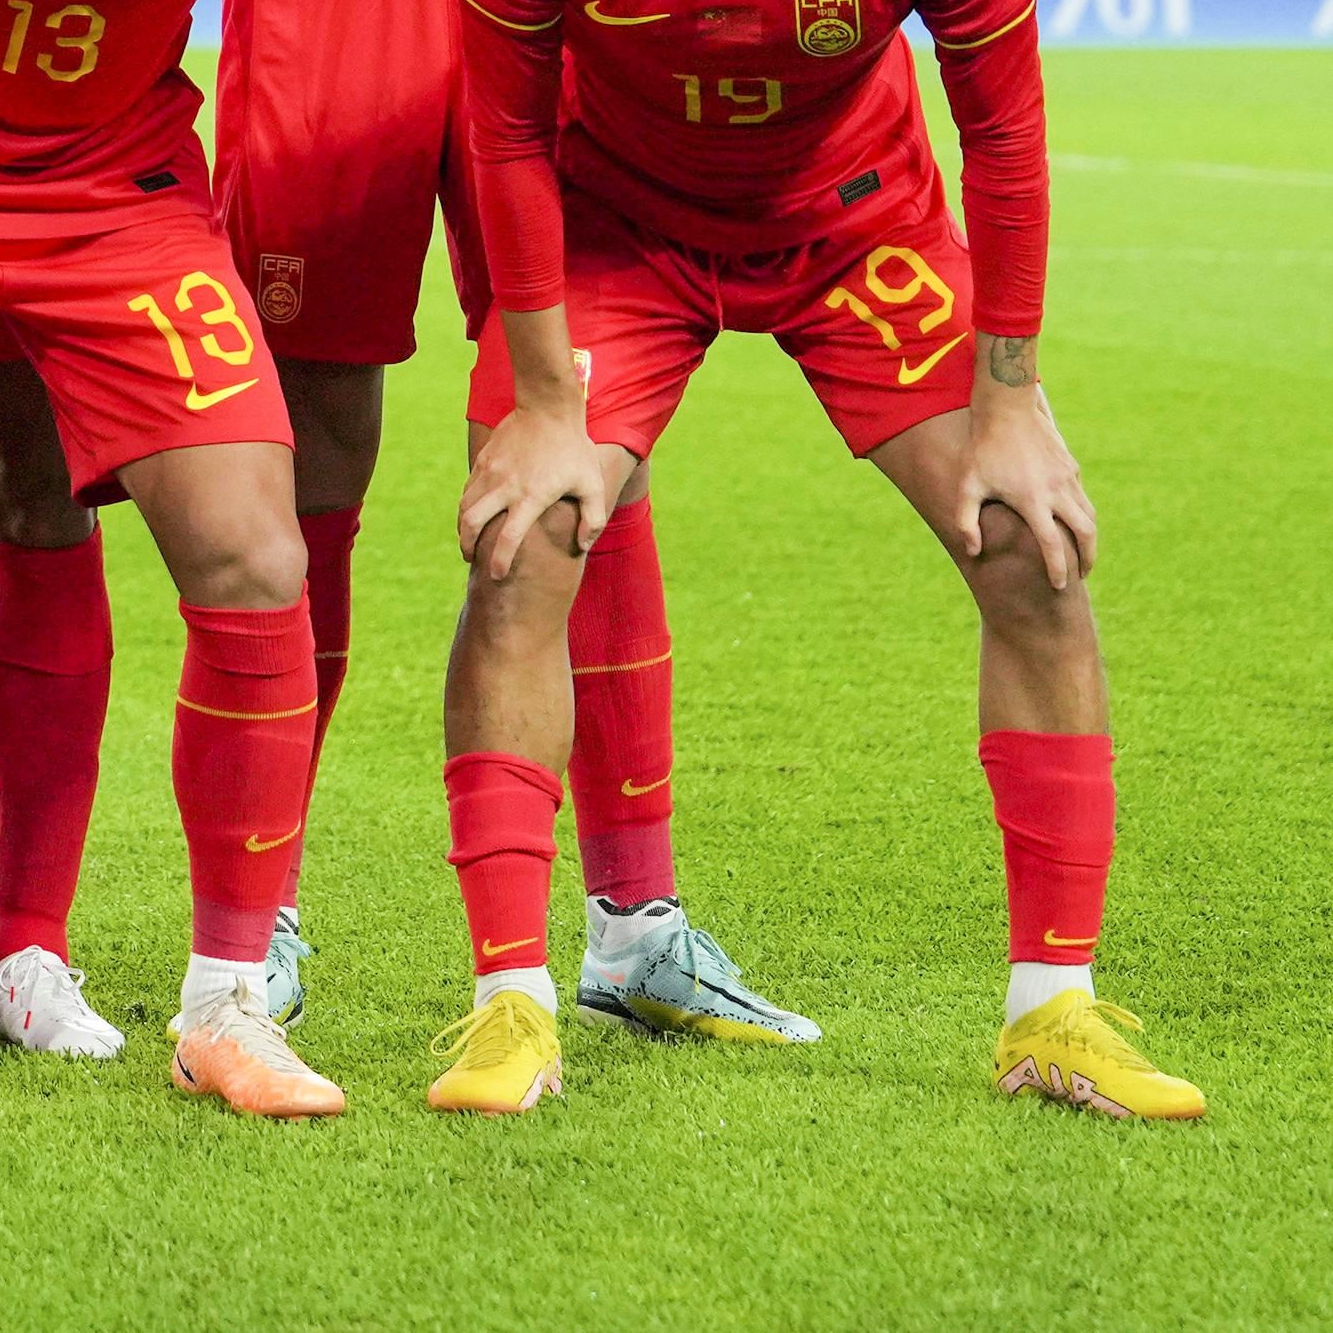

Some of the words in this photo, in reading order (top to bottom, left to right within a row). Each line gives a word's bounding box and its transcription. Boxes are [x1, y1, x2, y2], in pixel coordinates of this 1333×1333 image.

[1, 0, 106, 83] 13
[672, 73, 782, 124] 19
[264, 259, 300, 274] CFA
[825, 245, 955, 351] 19
[128, 270, 254, 379] 13
[997, 1055, 1136, 1117] AIR
